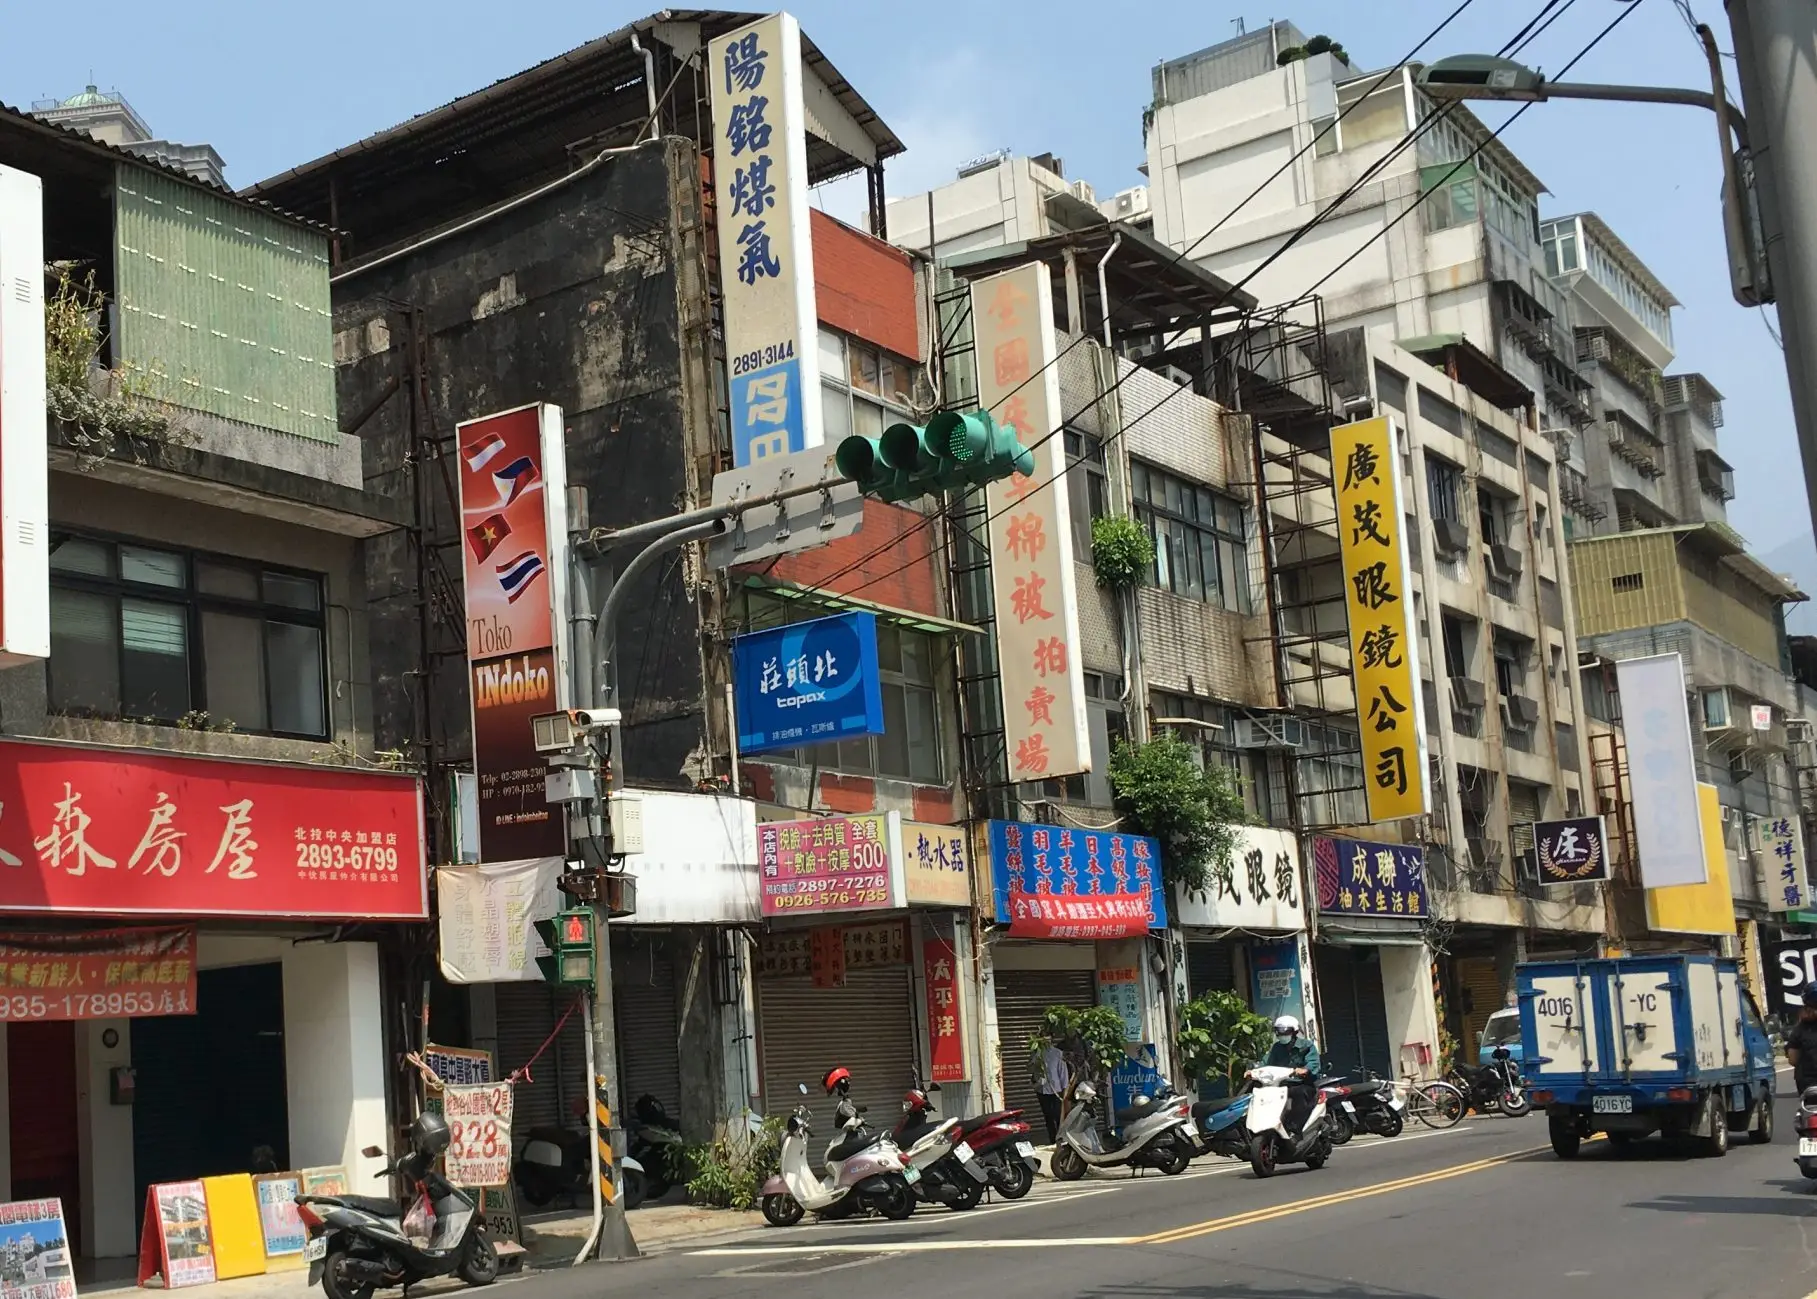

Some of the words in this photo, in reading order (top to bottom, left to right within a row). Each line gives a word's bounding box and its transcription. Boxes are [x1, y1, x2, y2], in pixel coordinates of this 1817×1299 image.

[725, 32, 781, 288] 陽銘煤氣
[732, 348, 795, 377] 2891-3144
[473, 614, 513, 654] Toko
[1341, 443, 1408, 796] 廣茂眼鏡公司
[476, 655, 550, 708] INdoko
[776, 690, 826, 709] topax
[0, 781, 259, 881] 森房屋
[294, 826, 398, 846] 北投中央加盟店
[851, 820, 879, 841] 全套
[295, 842, 399, 872] 2893-6799
[763, 830, 778, 877] 本店內有
[853, 841, 885, 870] 500
[917, 832, 964, 873] 熱水器
[1771, 817, 1804, 907] 德祥牙醫
[774, 888, 888, 908] 0926-576-735
[798, 875, 886, 893] 2897-7276
[1183, 847, 1298, 909] 茂眼鏡
[933, 958, 955, 1037] 太平洋
[1538, 997, 1574, 1017] 4016
